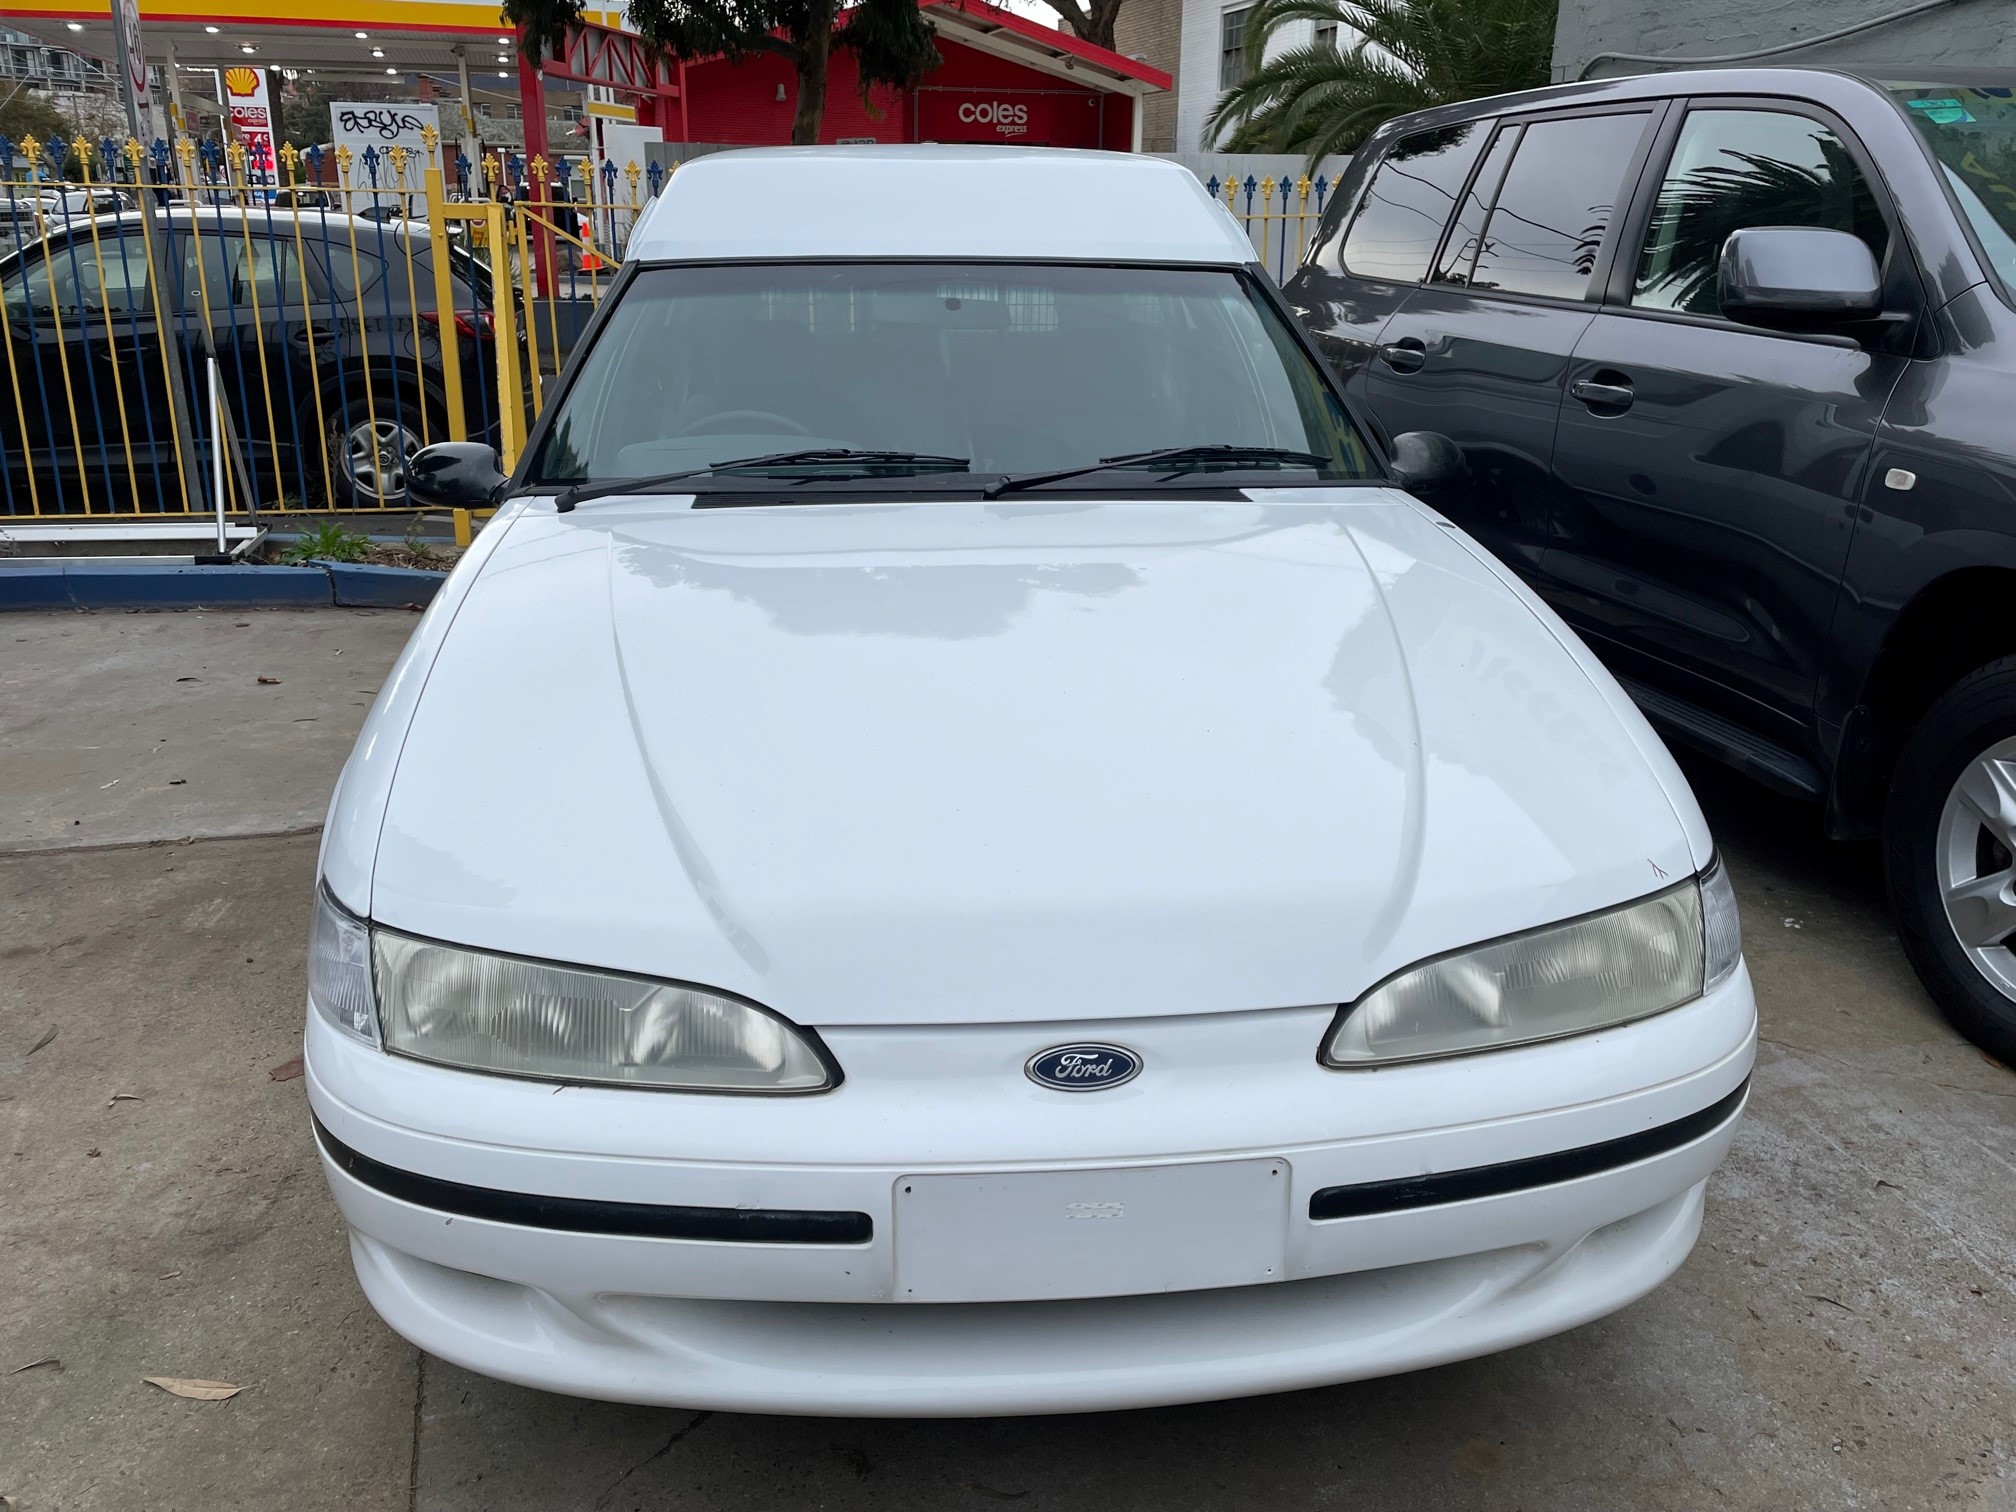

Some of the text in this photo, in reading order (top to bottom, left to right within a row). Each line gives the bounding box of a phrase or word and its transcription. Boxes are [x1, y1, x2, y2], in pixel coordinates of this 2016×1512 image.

[958, 101, 1028, 124] coles
[996, 125, 1028, 135] express
[1055, 1053, 1114, 1078] Ford
